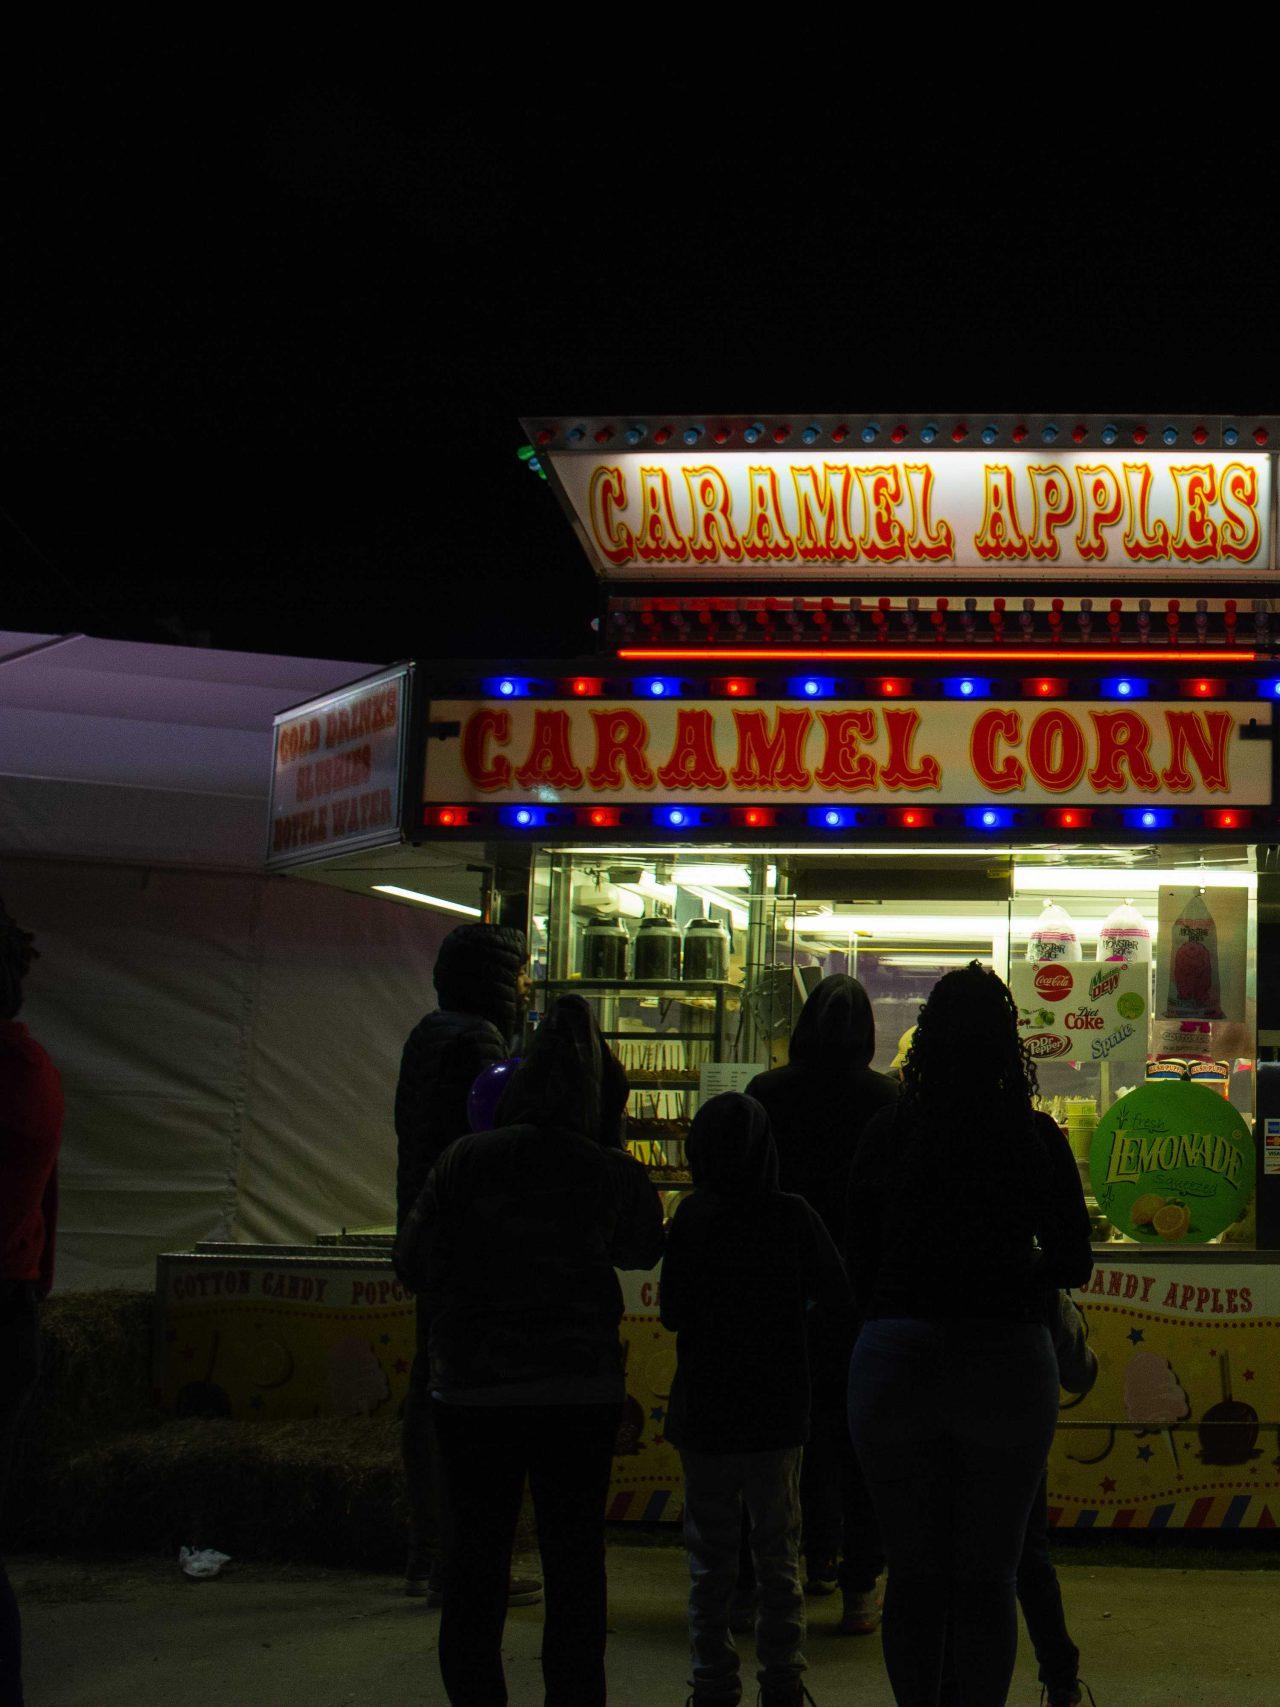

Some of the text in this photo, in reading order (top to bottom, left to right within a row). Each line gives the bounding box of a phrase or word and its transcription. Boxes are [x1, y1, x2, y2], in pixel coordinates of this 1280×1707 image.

[589, 463, 1261, 563] CARAMEL APPLES
[461, 706, 1232, 793] CARAMEL CORN
[1064, 1012, 1105, 1030] Coke
[1076, 1006, 1099, 1017] Diet
[1027, 1039, 1061, 1056] Pepper
[1104, 1129, 1244, 1190] LEMONADE
[173, 1270, 250, 1300] COTTON
[262, 1272, 327, 1302] CANDY
[1162, 1283, 1253, 1314] APPLES
